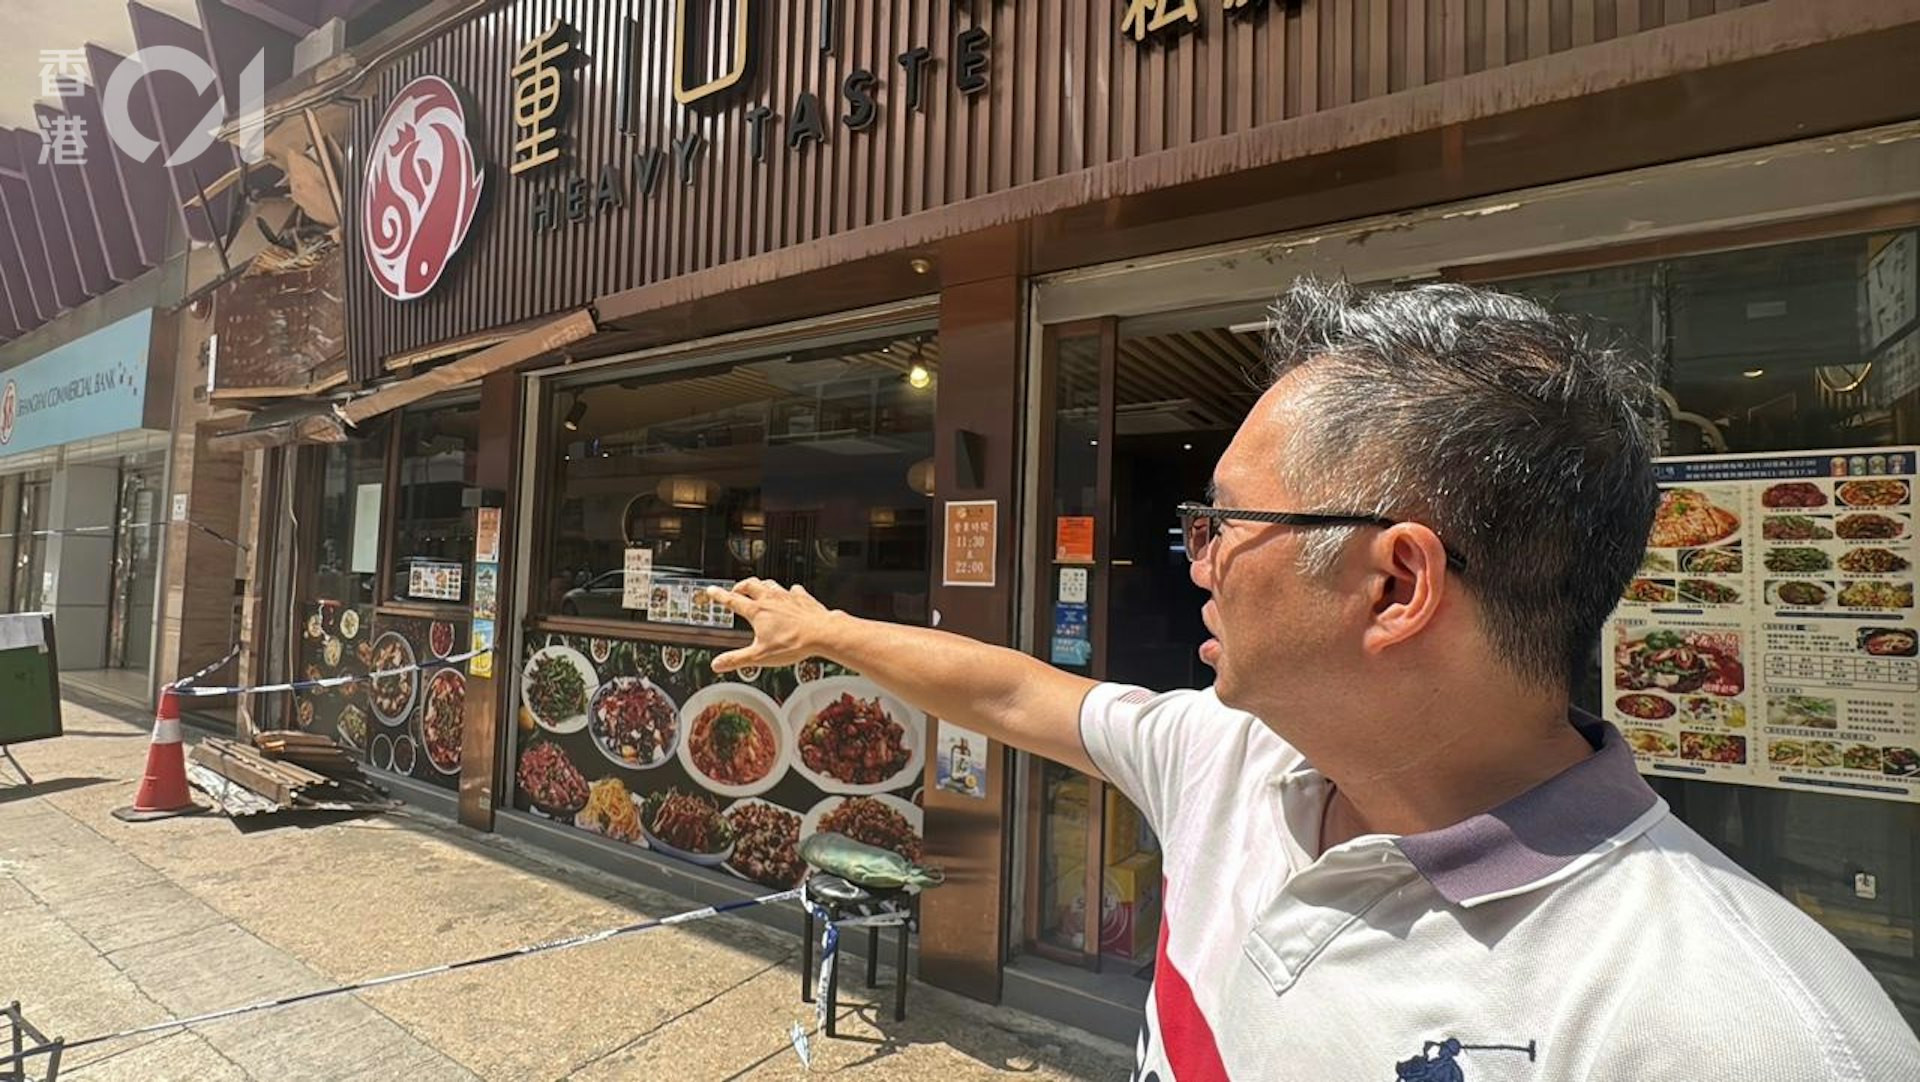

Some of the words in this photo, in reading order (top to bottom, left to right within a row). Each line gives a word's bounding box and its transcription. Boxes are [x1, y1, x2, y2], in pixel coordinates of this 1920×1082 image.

[510, 19, 570, 176] 重
[532, 132, 708, 234] HEAVY
[744, 26, 991, 163] TASTE
[48, 375, 94, 408] COMMERCIAL
[94, 369, 116, 394] BANK
[957, 536, 985, 548] 11:30
[955, 561, 984, 574] 22:00
